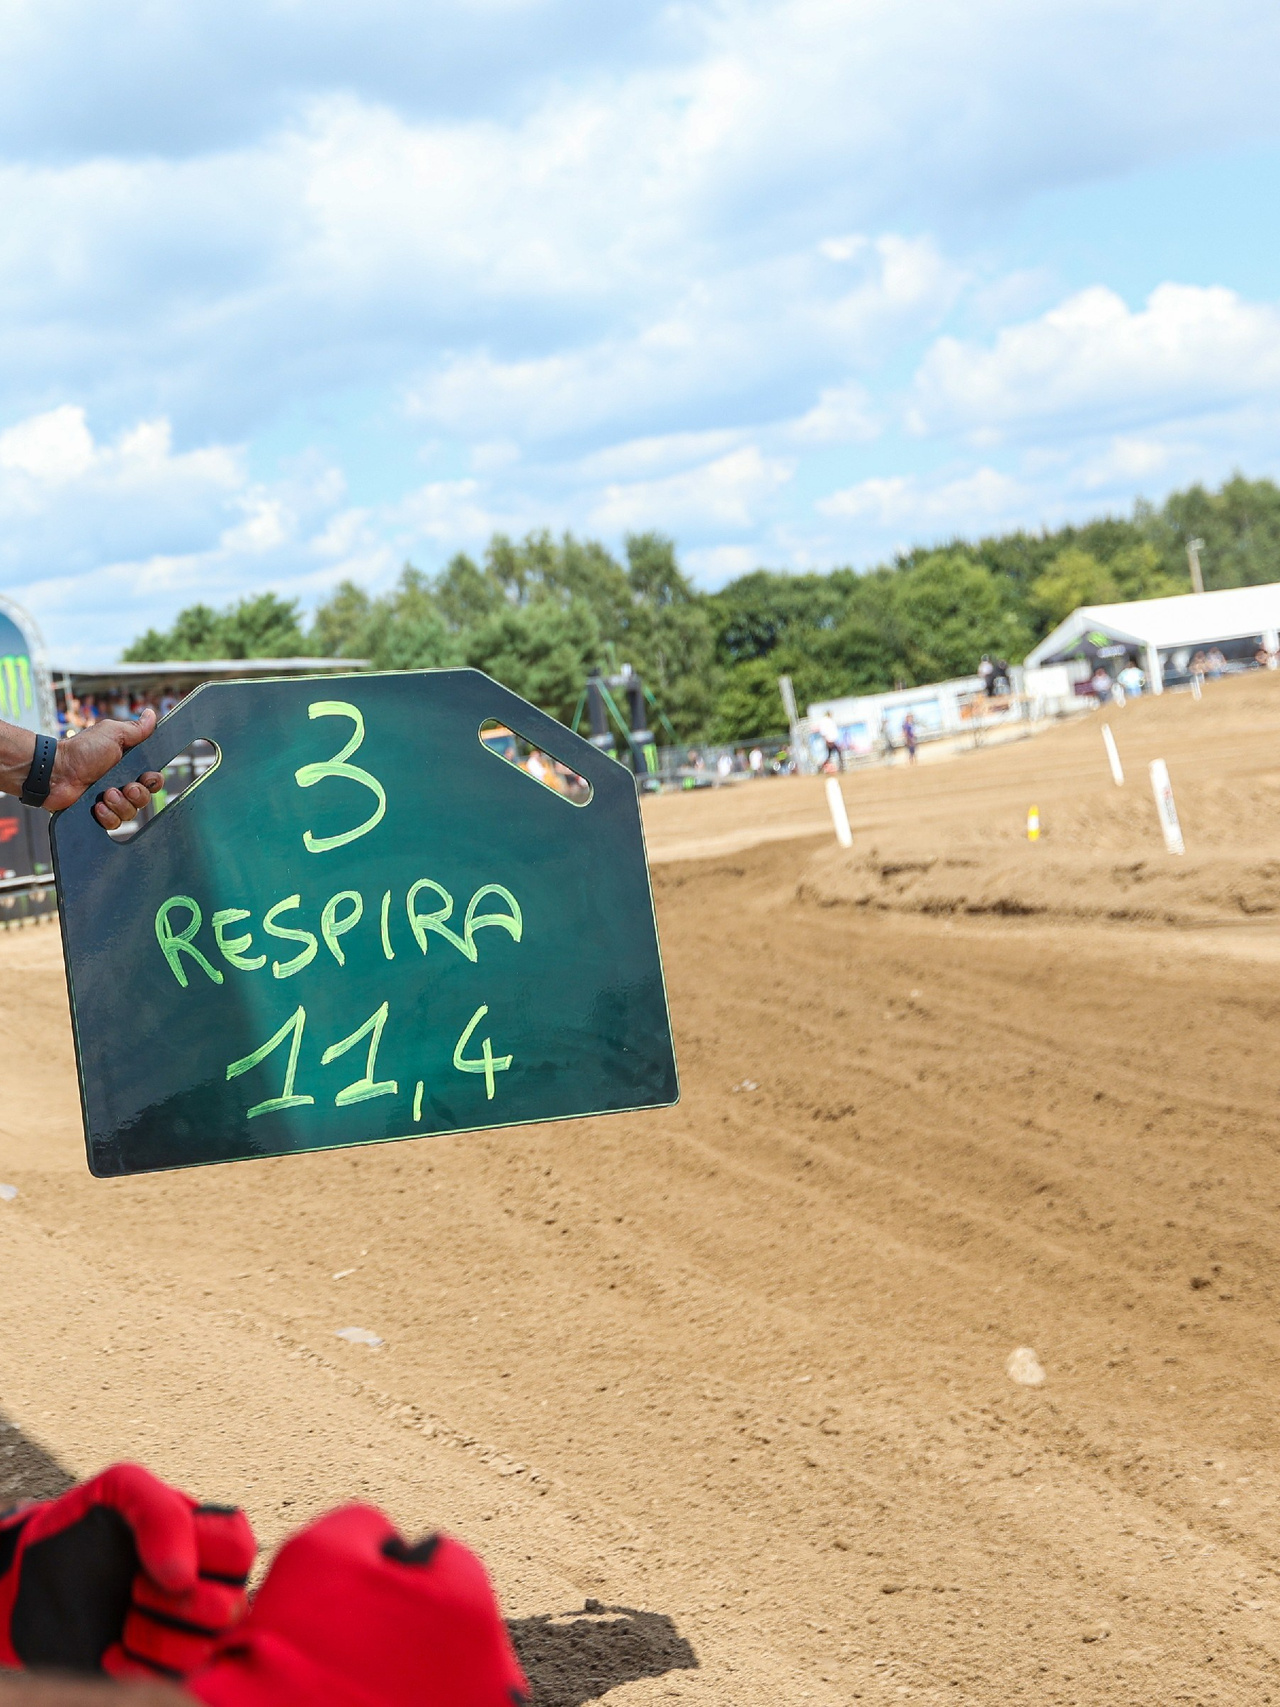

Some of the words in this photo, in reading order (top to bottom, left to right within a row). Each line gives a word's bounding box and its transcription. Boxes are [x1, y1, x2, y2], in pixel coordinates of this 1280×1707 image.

[295, 701, 386, 853] 3
[155, 878, 522, 988] RESPIRA
[226, 1001, 513, 1121] 11,4
